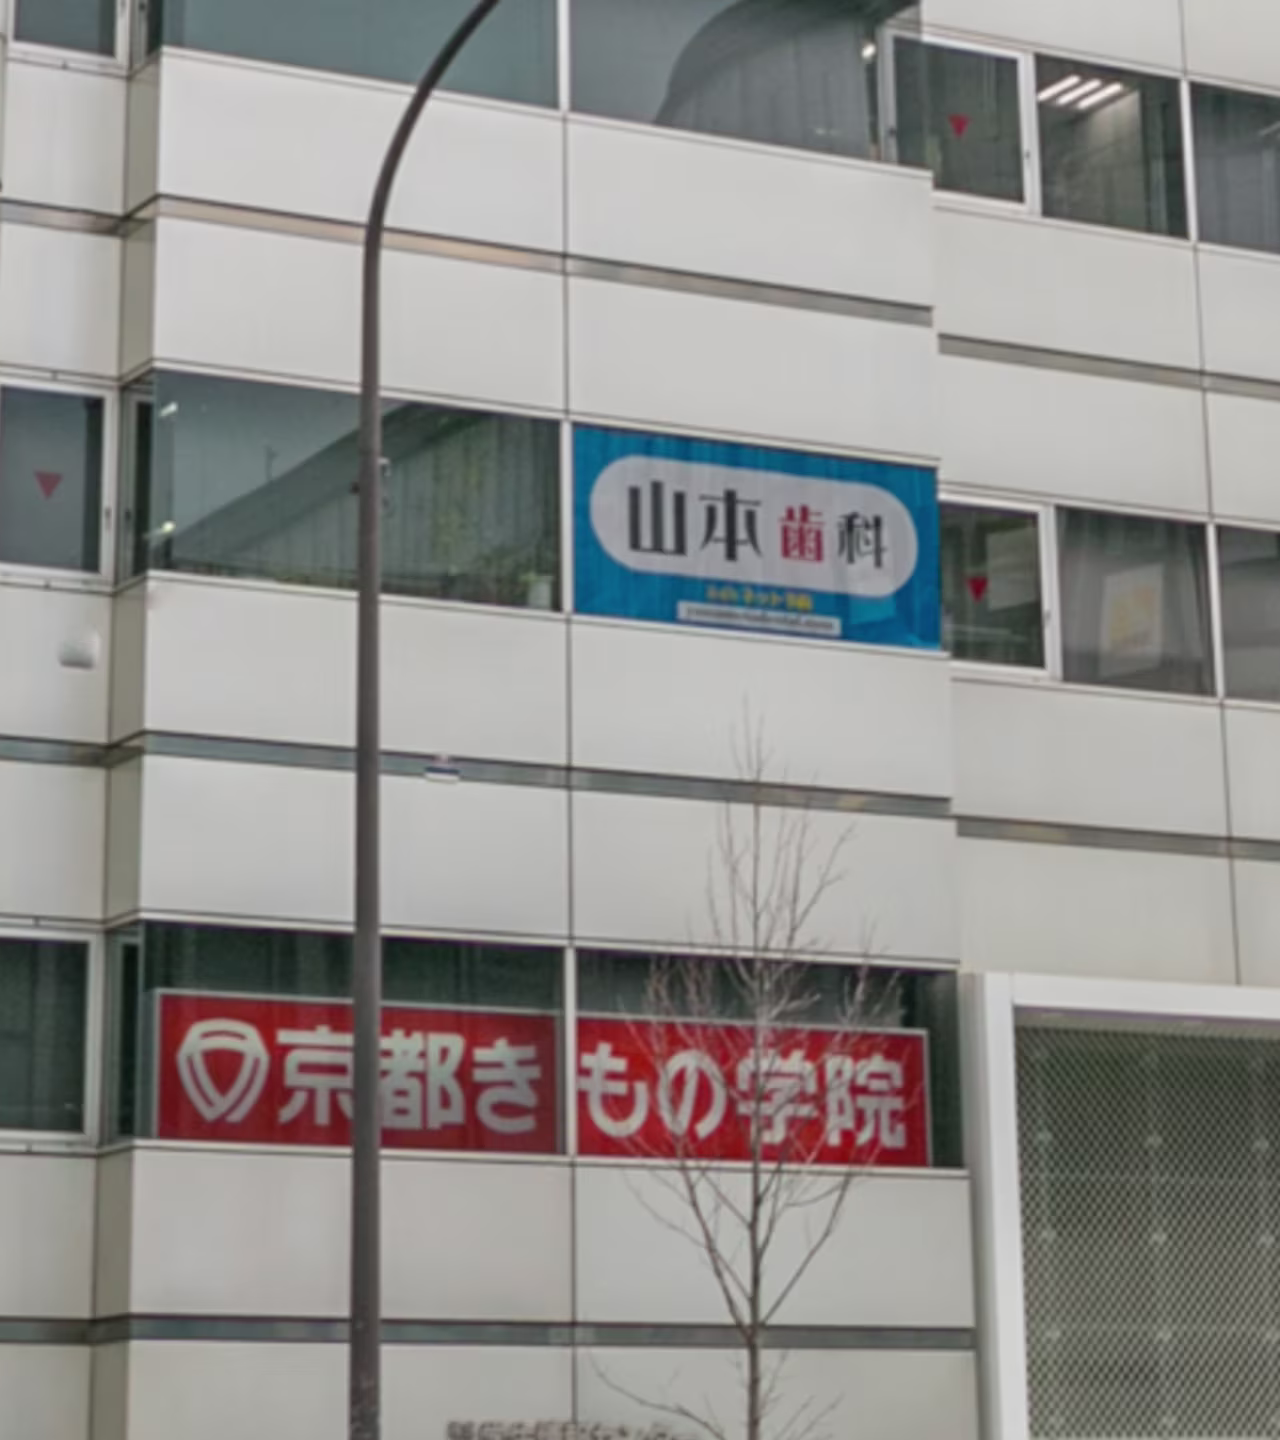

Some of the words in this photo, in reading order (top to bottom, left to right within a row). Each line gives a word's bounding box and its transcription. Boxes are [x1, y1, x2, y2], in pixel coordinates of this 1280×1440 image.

[626, 480, 889, 569] 山本歯科
[275, 1022, 907, 1149] 京都きもの学院
